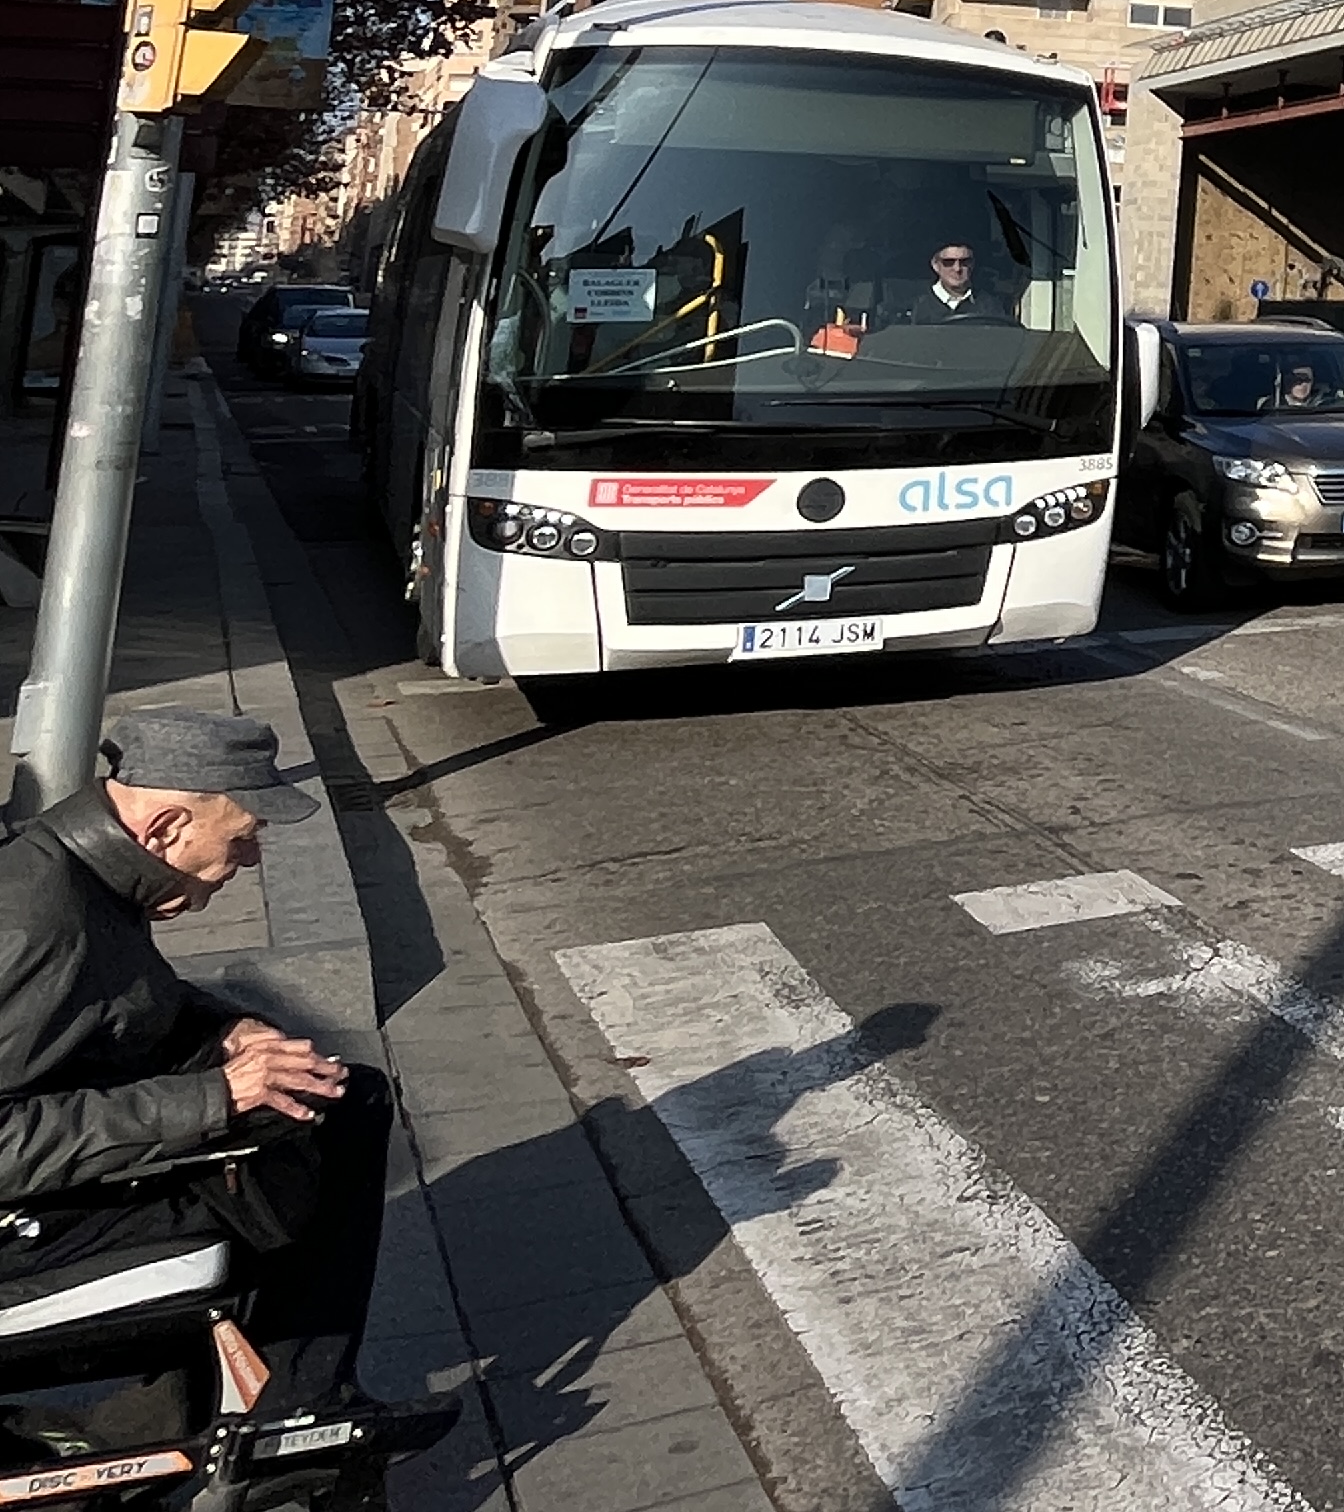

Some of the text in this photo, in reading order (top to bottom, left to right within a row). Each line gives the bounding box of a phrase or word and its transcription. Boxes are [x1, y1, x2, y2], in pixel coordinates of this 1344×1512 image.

[1079, 457, 1113, 472] 3885
[899, 471, 1012, 512] alsa
[759, 622, 876, 649] 2114 JSM
